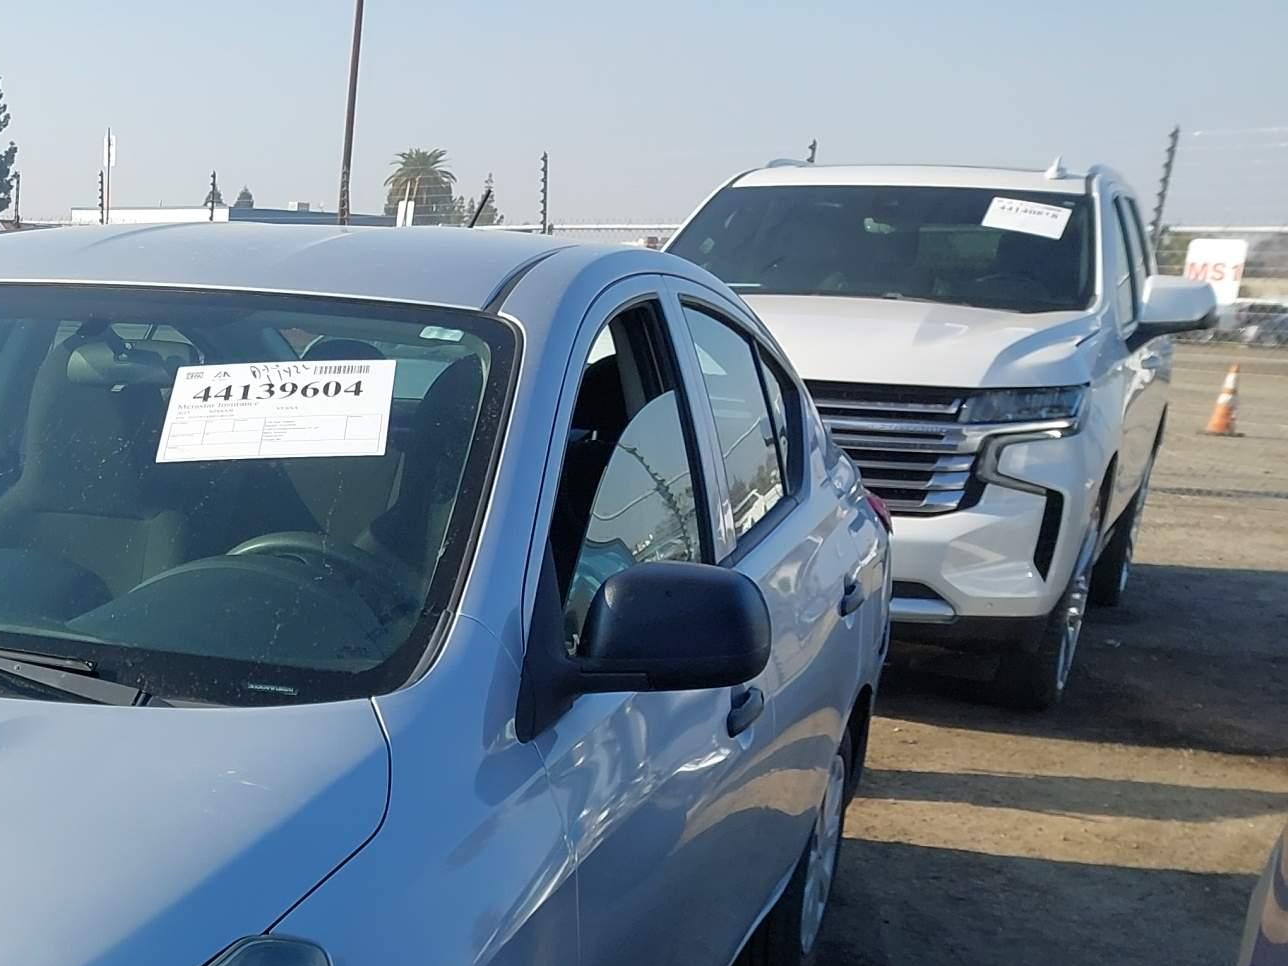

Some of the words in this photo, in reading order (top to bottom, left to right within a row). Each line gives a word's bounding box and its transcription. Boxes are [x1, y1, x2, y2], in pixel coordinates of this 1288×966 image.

[1187, 261, 1227, 281] MS
[1231, 264, 1243, 281] 1
[193, 380, 364, 402] 44139604
